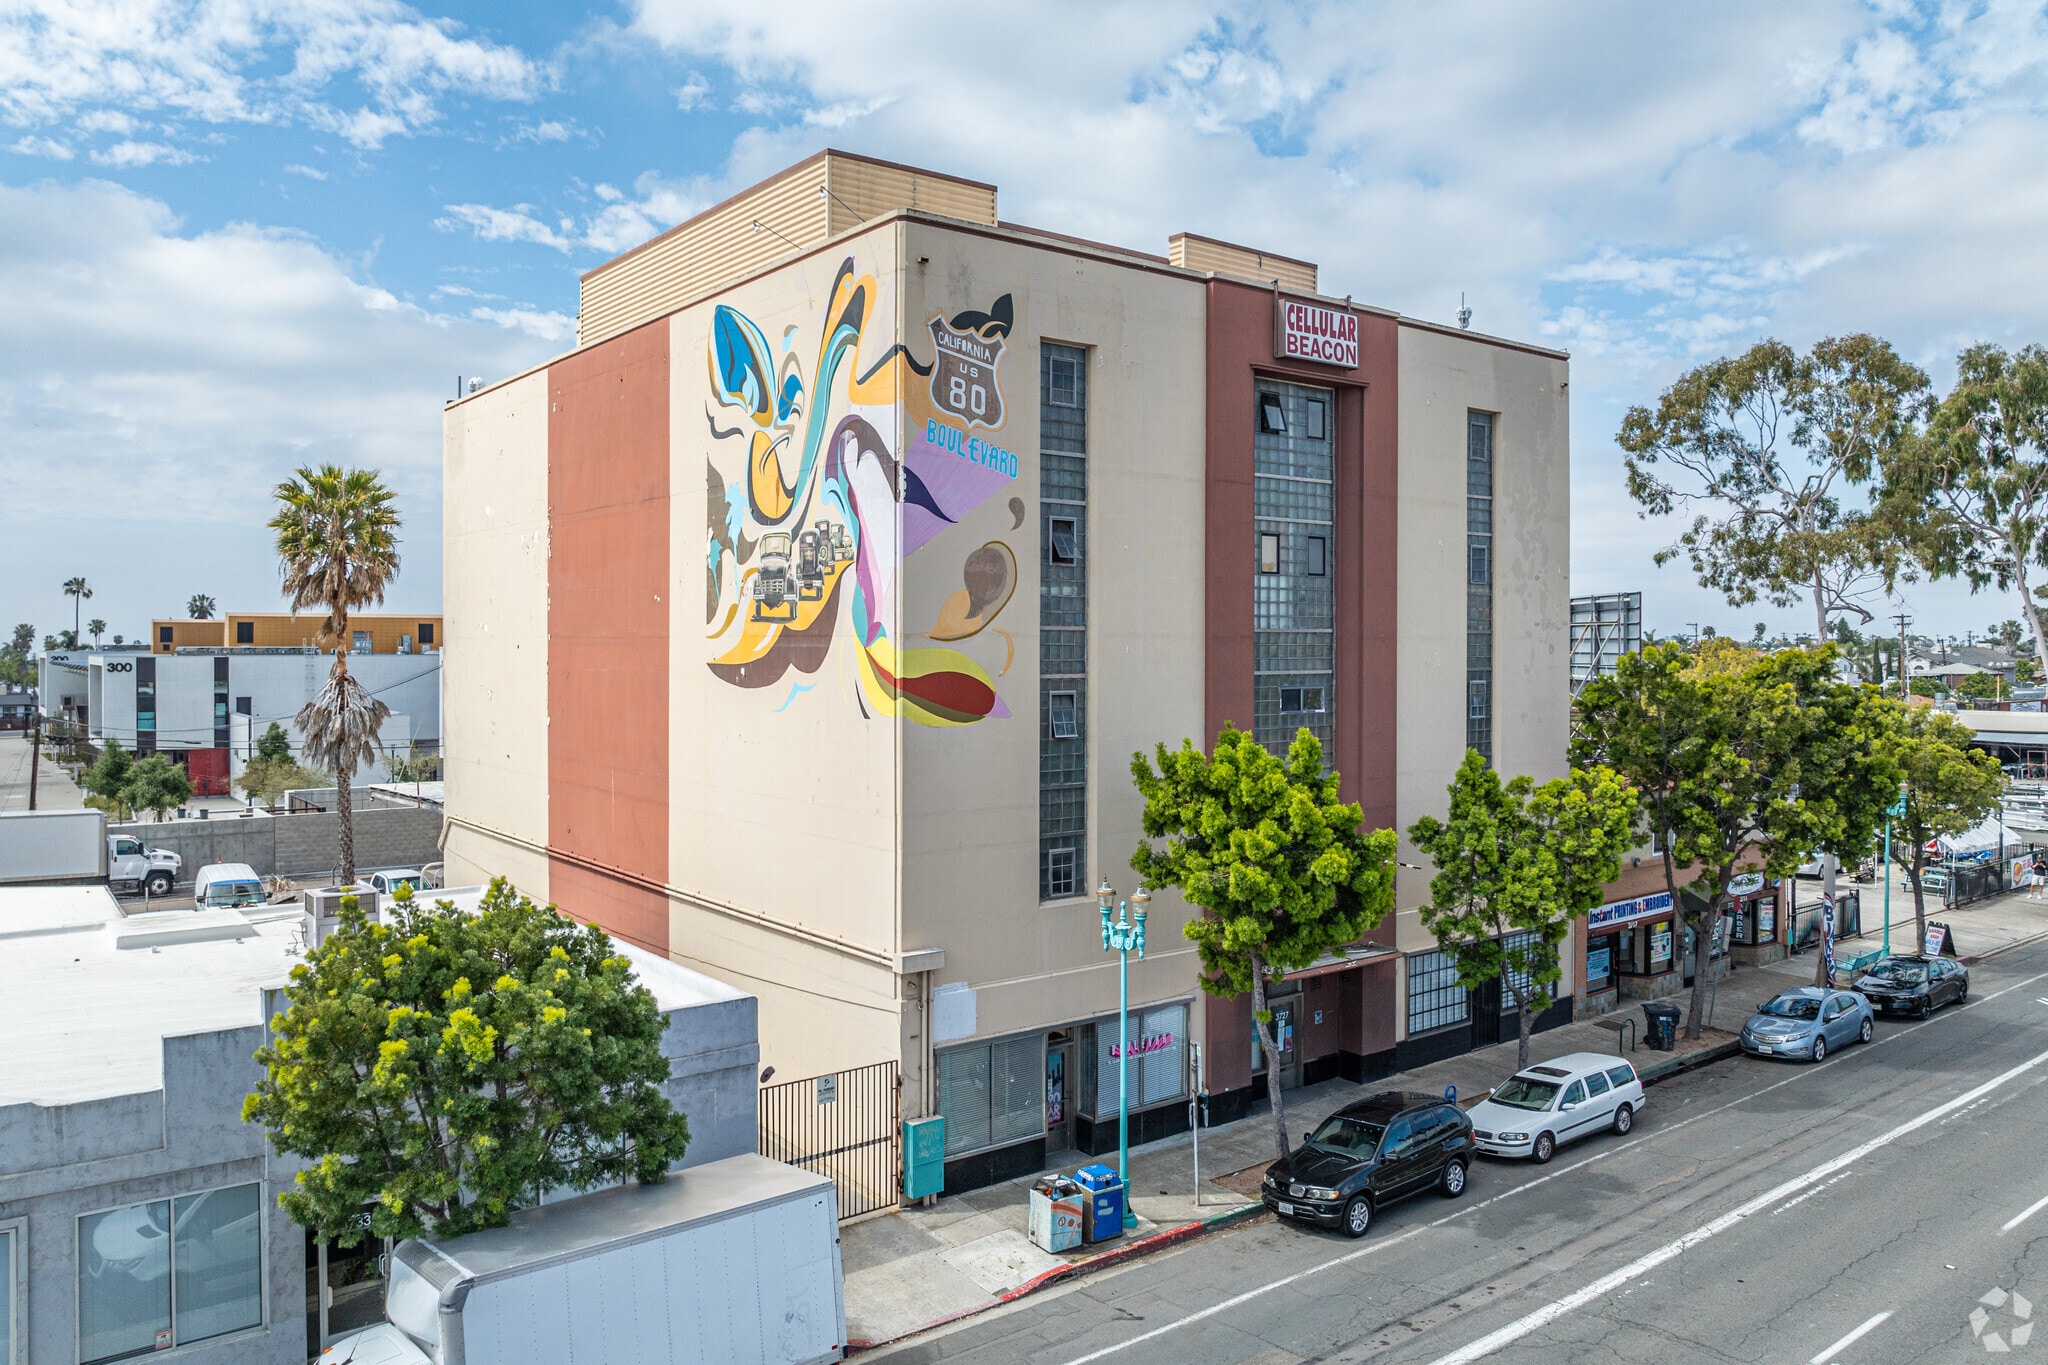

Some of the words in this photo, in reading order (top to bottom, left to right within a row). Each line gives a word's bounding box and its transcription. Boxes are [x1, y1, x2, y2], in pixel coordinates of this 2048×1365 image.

[1287, 304, 1357, 343] CELLULAR
[938, 331, 992, 362] CALIFORNIA
[1287, 333, 1357, 365] BEACON
[949, 376, 986, 416] 80
[926, 417, 1019, 480] BOULEVARD
[107, 662, 133, 673] 300
[1589, 907, 1613, 924] Instant
[1614, 901, 1638, 919] PRINTING
[1275, 1010, 1289, 1021] 3727
